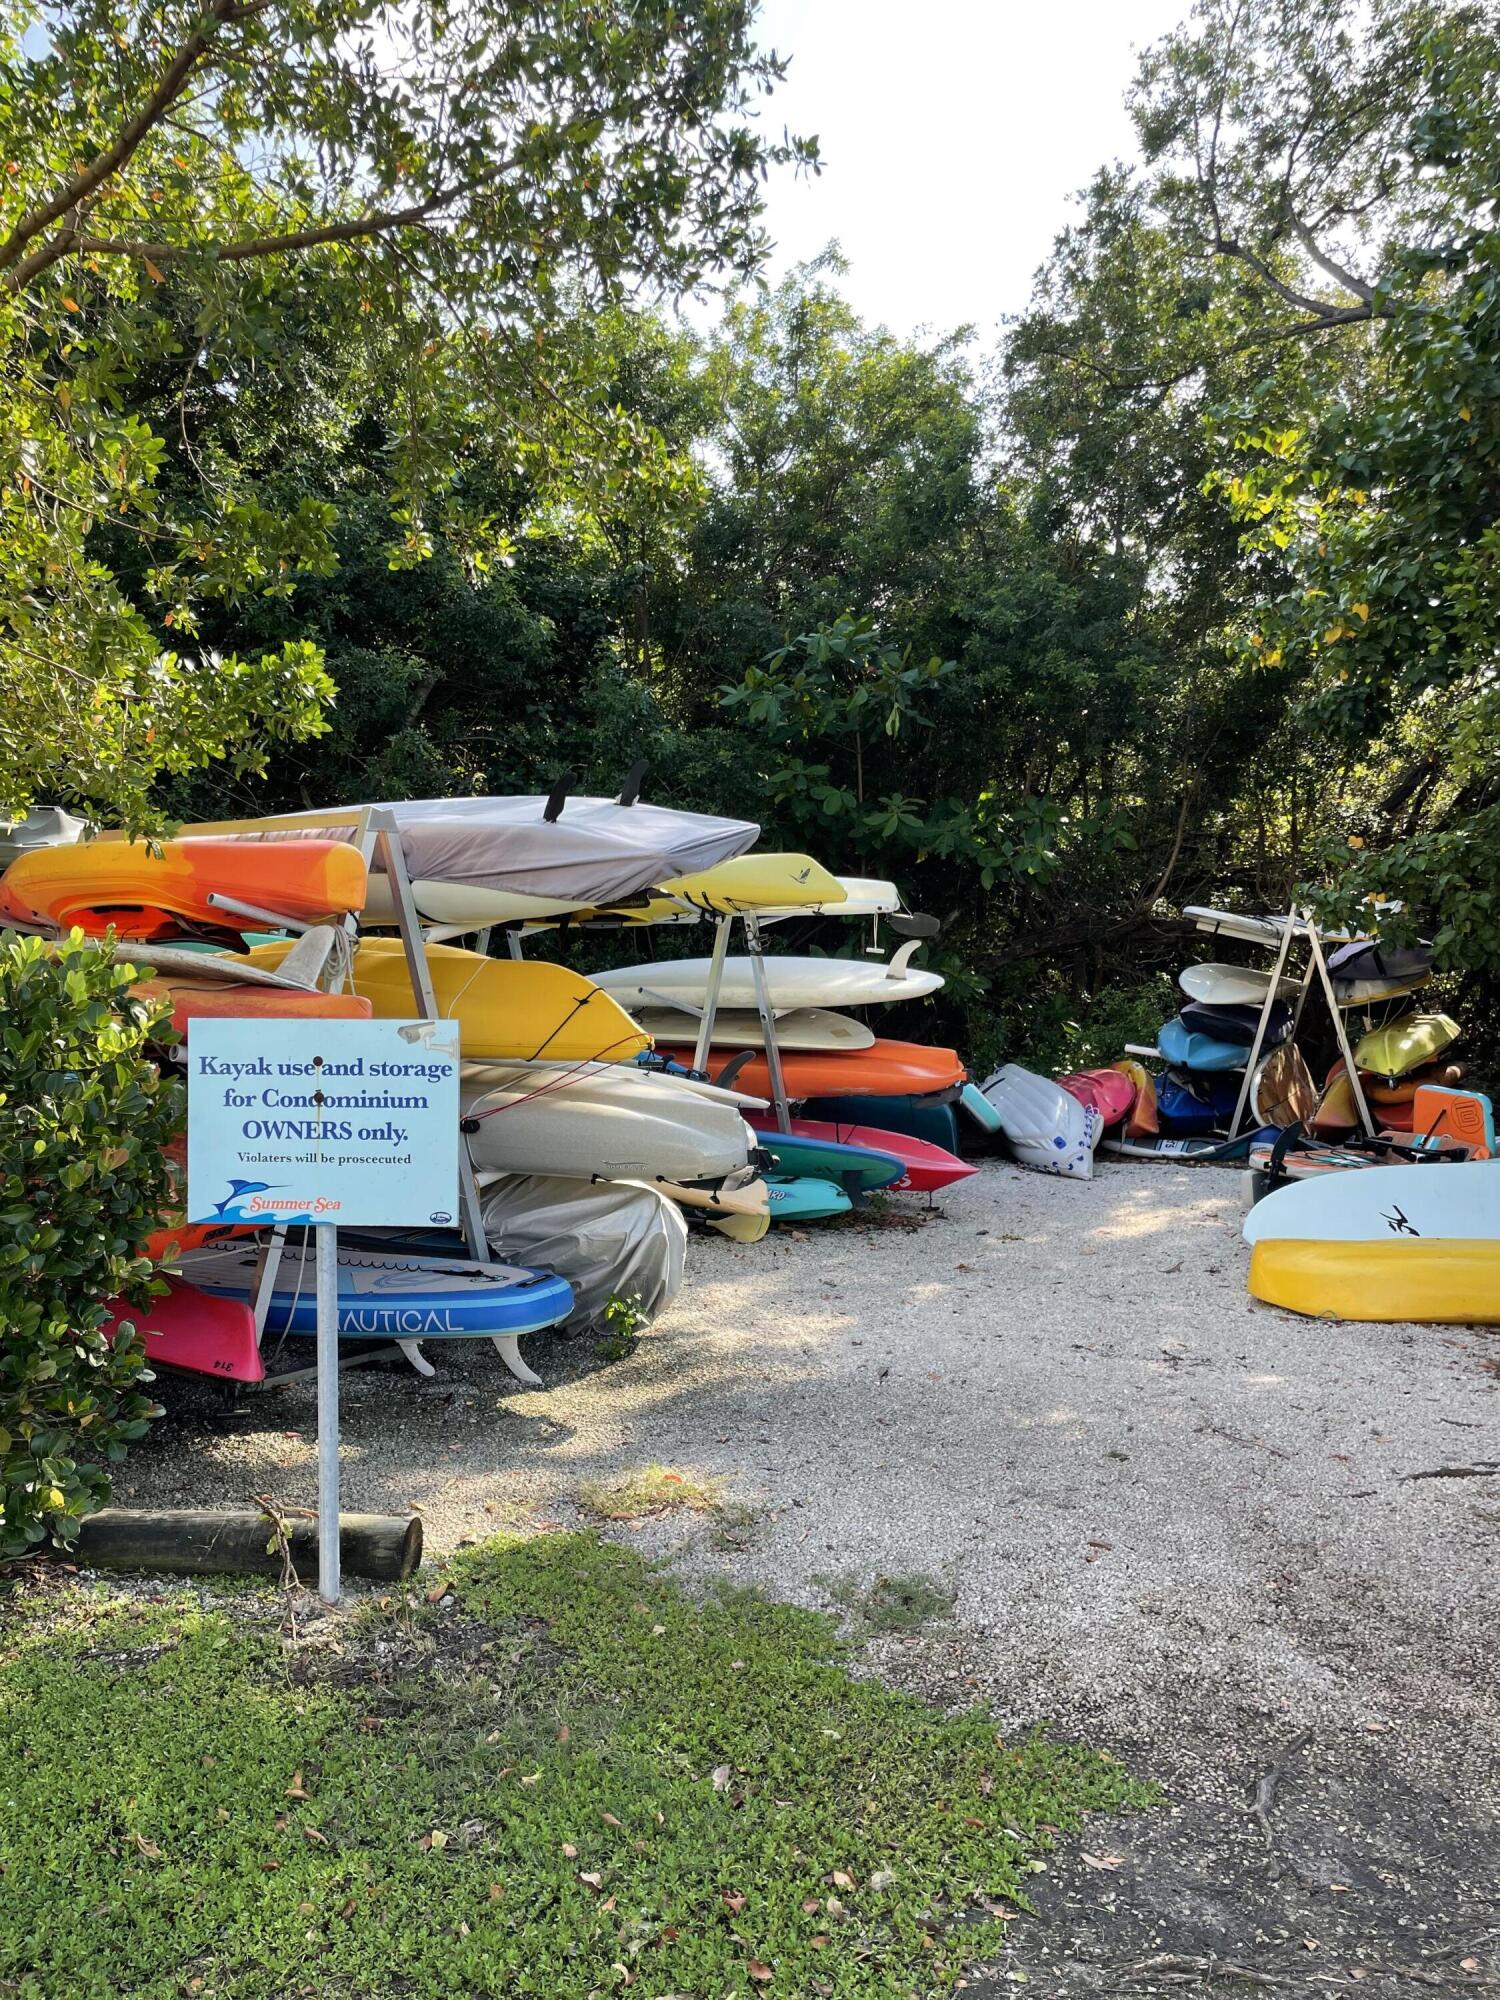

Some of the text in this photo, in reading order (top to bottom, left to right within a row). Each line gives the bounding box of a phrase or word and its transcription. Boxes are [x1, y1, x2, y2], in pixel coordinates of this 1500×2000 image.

[199, 1056, 452, 1083] Kayak use and storage
[223, 1088, 256, 1107] for
[242, 1120, 408, 1146] OWNERS only.
[238, 1151, 412, 1166] Violaters will be proscecuted
[250, 1196, 341, 1212] Summer Sea
[337, 1309, 464, 1332] AUTICAL
